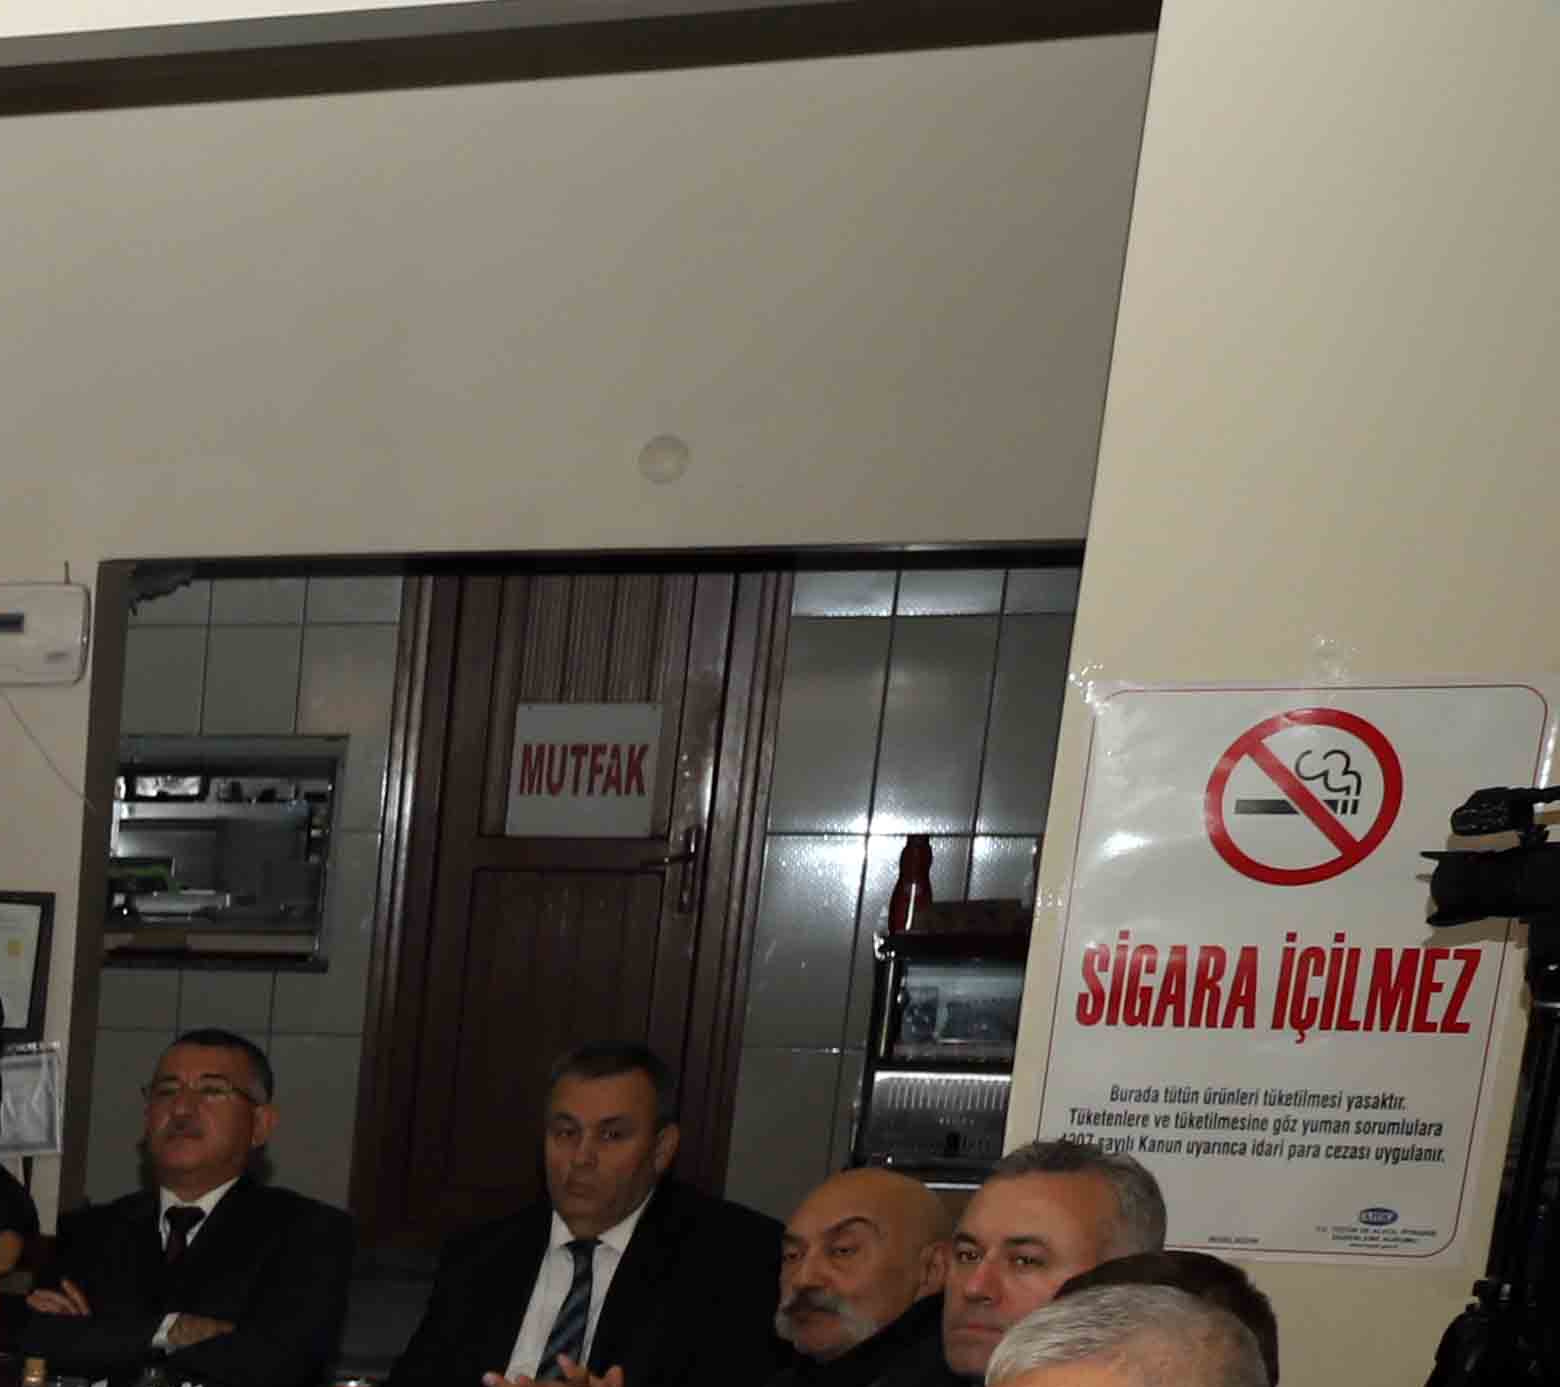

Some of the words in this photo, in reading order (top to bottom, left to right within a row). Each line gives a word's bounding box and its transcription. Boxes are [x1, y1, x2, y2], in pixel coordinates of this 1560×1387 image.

[520, 743, 649, 796] MUTFAK
[1075, 930, 1259, 1028] SİGARA
[1271, 931, 1482, 1044] İÇİLMEZ
[1110, 1084, 1160, 1104] Burada
[1163, 1086, 1199, 1105] tütün
[1203, 1087, 1259, 1106] ürünleri
[1263, 1088, 1343, 1109] tüketilmesi
[1345, 1090, 1407, 1112] yasaktır.
[1070, 1108, 1150, 1128] Tüketenlere
[1153, 1114, 1170, 1128] ve
[1174, 1111, 1269, 1131] tüketilmesine
[1272, 1116, 1298, 1136] göz
[1302, 1119, 1350, 1136] yuman
[1354, 1117, 1444, 1137] sorumlulara
[1139, 1135, 1182, 1153] Kanun
[1185, 1138, 1248, 1158] uyarınca
[1251, 1138, 1284, 1157] idari
[1287, 1143, 1321, 1160] para
[1324, 1144, 1370, 1161] cezası
[1374, 1144, 1446, 1165] uygulanır.
